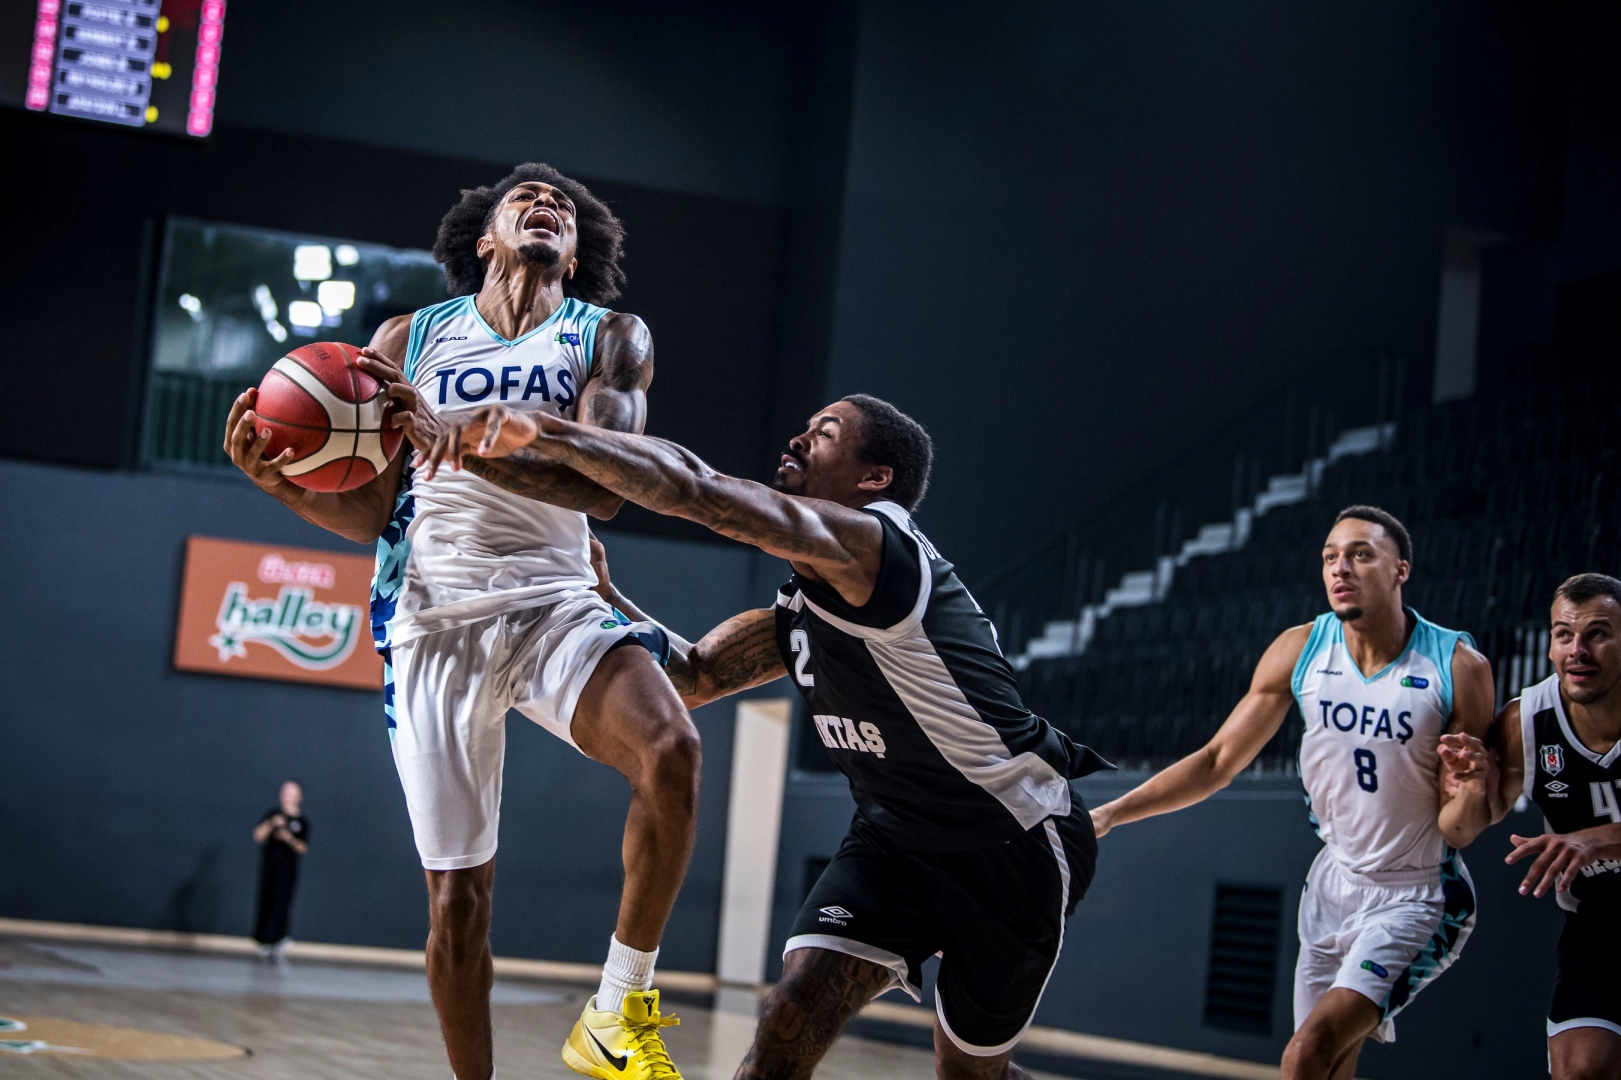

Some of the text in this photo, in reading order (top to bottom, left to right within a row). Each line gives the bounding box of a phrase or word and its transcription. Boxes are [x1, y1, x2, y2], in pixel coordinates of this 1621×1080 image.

[436, 365, 576, 412] TOFAŞ
[216, 581, 364, 665] halley
[789, 629, 815, 686] 2
[813, 714, 887, 758] KTAŞ
[1319, 700, 1414, 745] TOFAŞ
[1353, 747, 1379, 793] 8
[1589, 779, 1621, 824] 4
[818, 916, 847, 927] umbro
